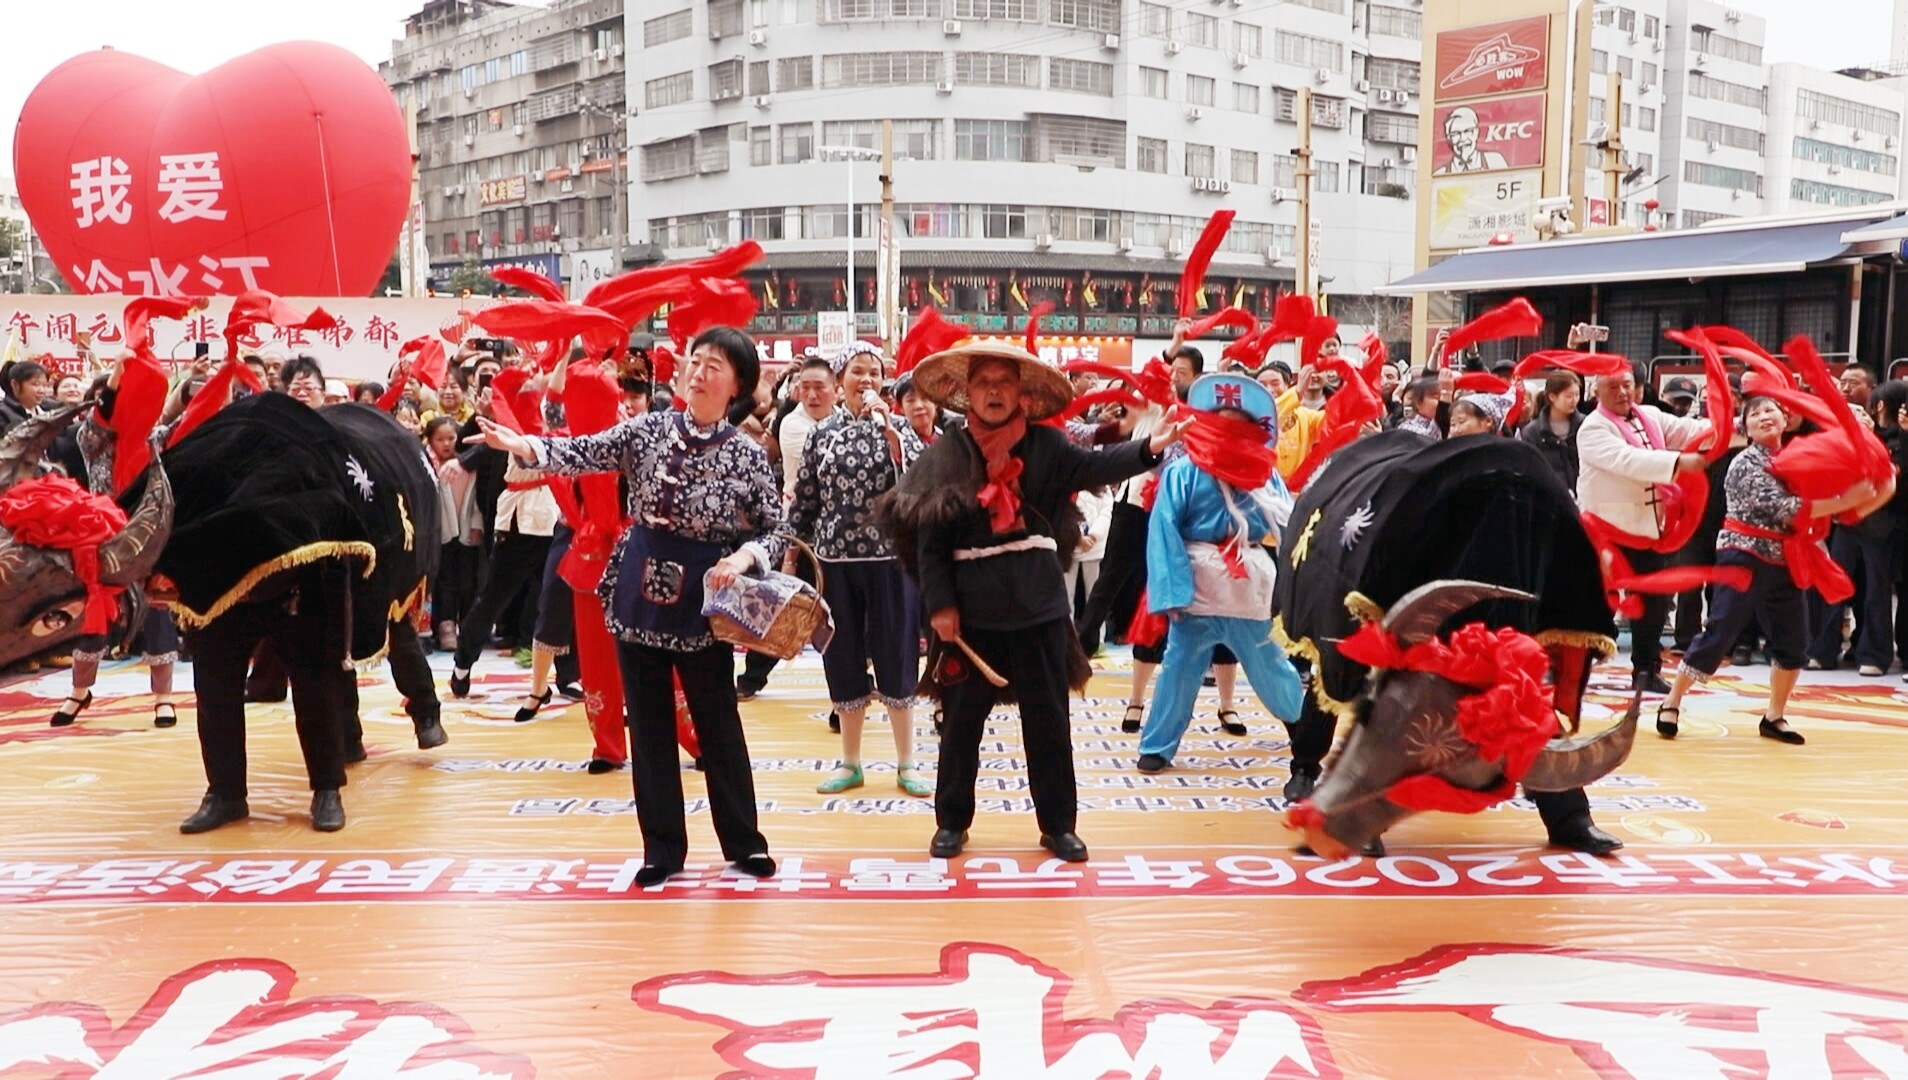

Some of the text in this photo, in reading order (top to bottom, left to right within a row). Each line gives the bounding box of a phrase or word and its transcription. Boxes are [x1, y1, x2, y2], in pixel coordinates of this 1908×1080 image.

[1496, 66, 1525, 81] WOW
[1485, 120, 1535, 143] KFC
[70, 152, 228, 228] 我爱
[1496, 181, 1523, 200] 5F
[1468, 212, 1527, 231] 潇湘影城
[5, 310, 155, 349] 午闹元
